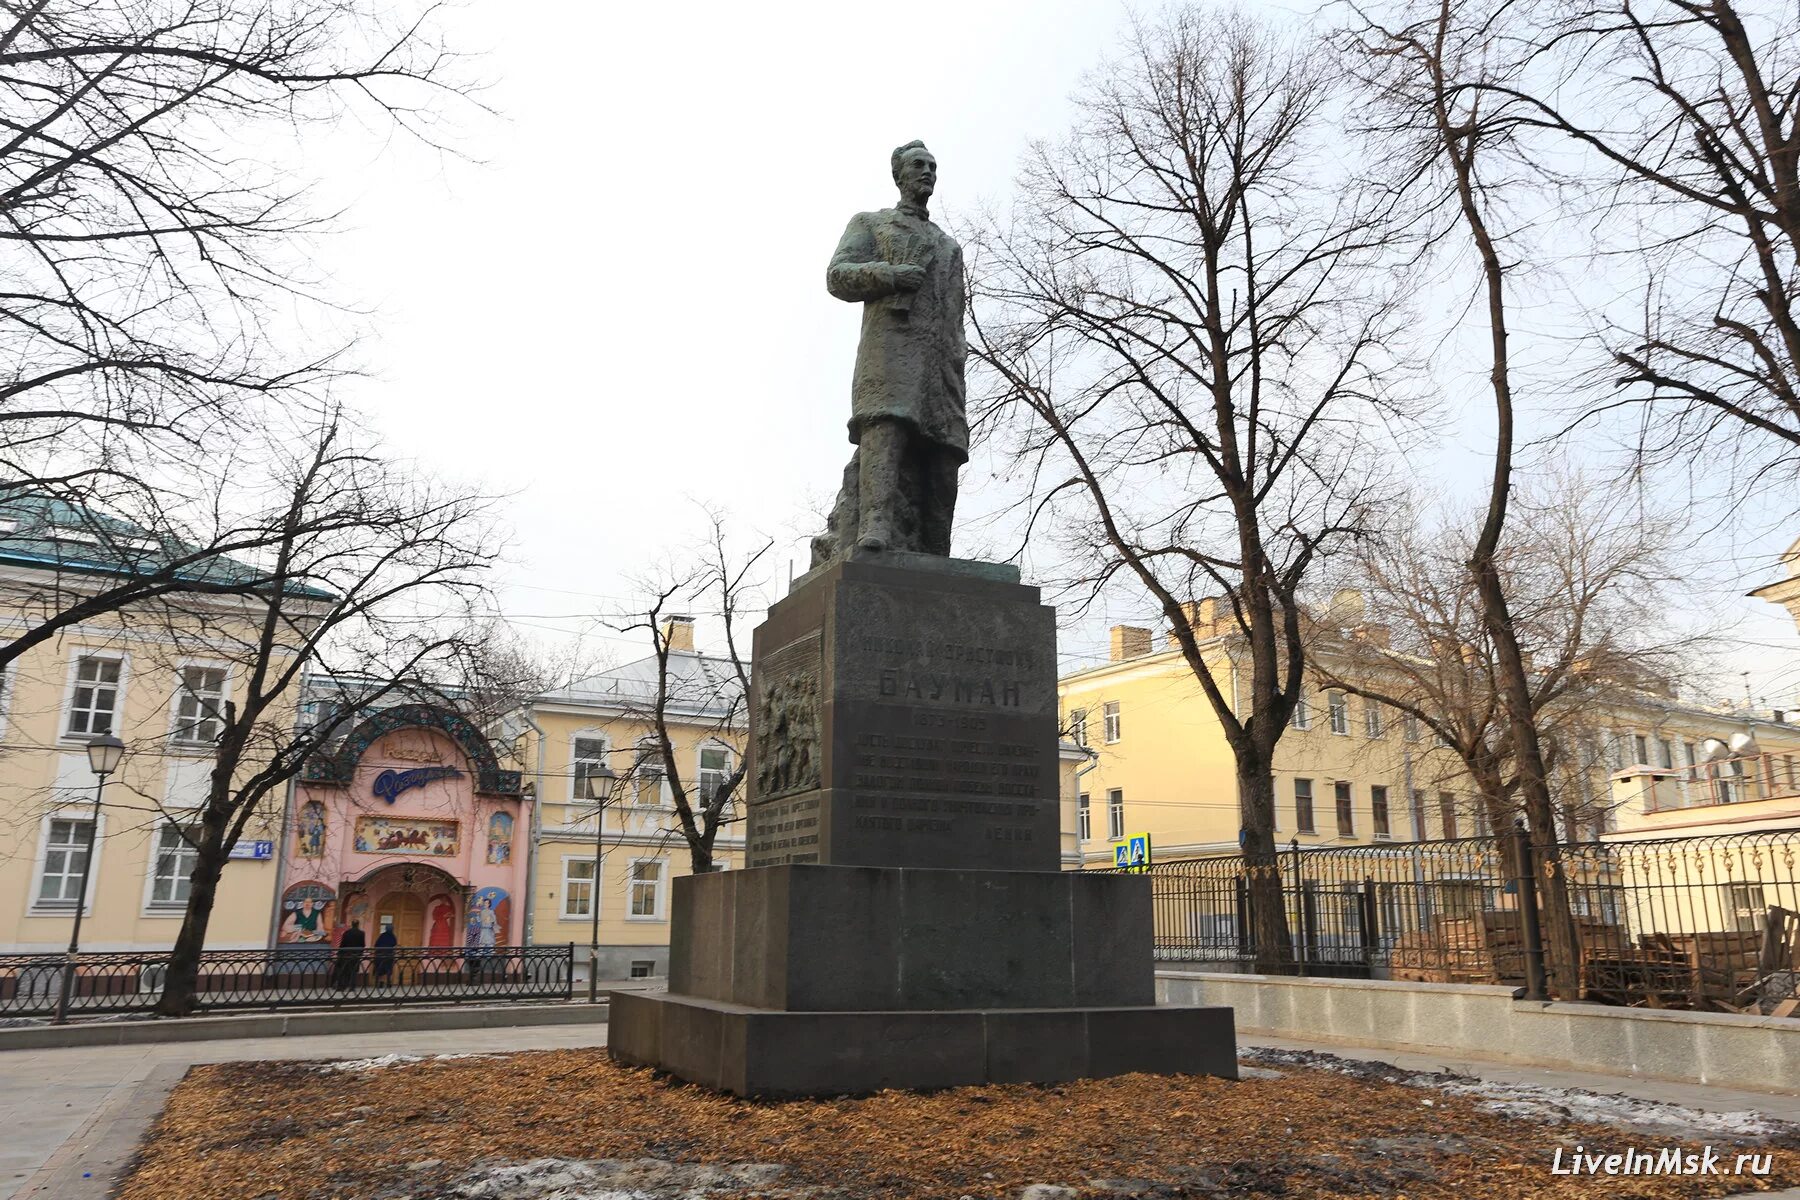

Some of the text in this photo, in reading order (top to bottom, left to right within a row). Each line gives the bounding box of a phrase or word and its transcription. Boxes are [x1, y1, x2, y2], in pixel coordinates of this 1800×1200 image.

[879, 669, 1021, 707] БАУМАН
[913, 713, 987, 731] 1873-1905
[257, 843, 270, 854] 11
